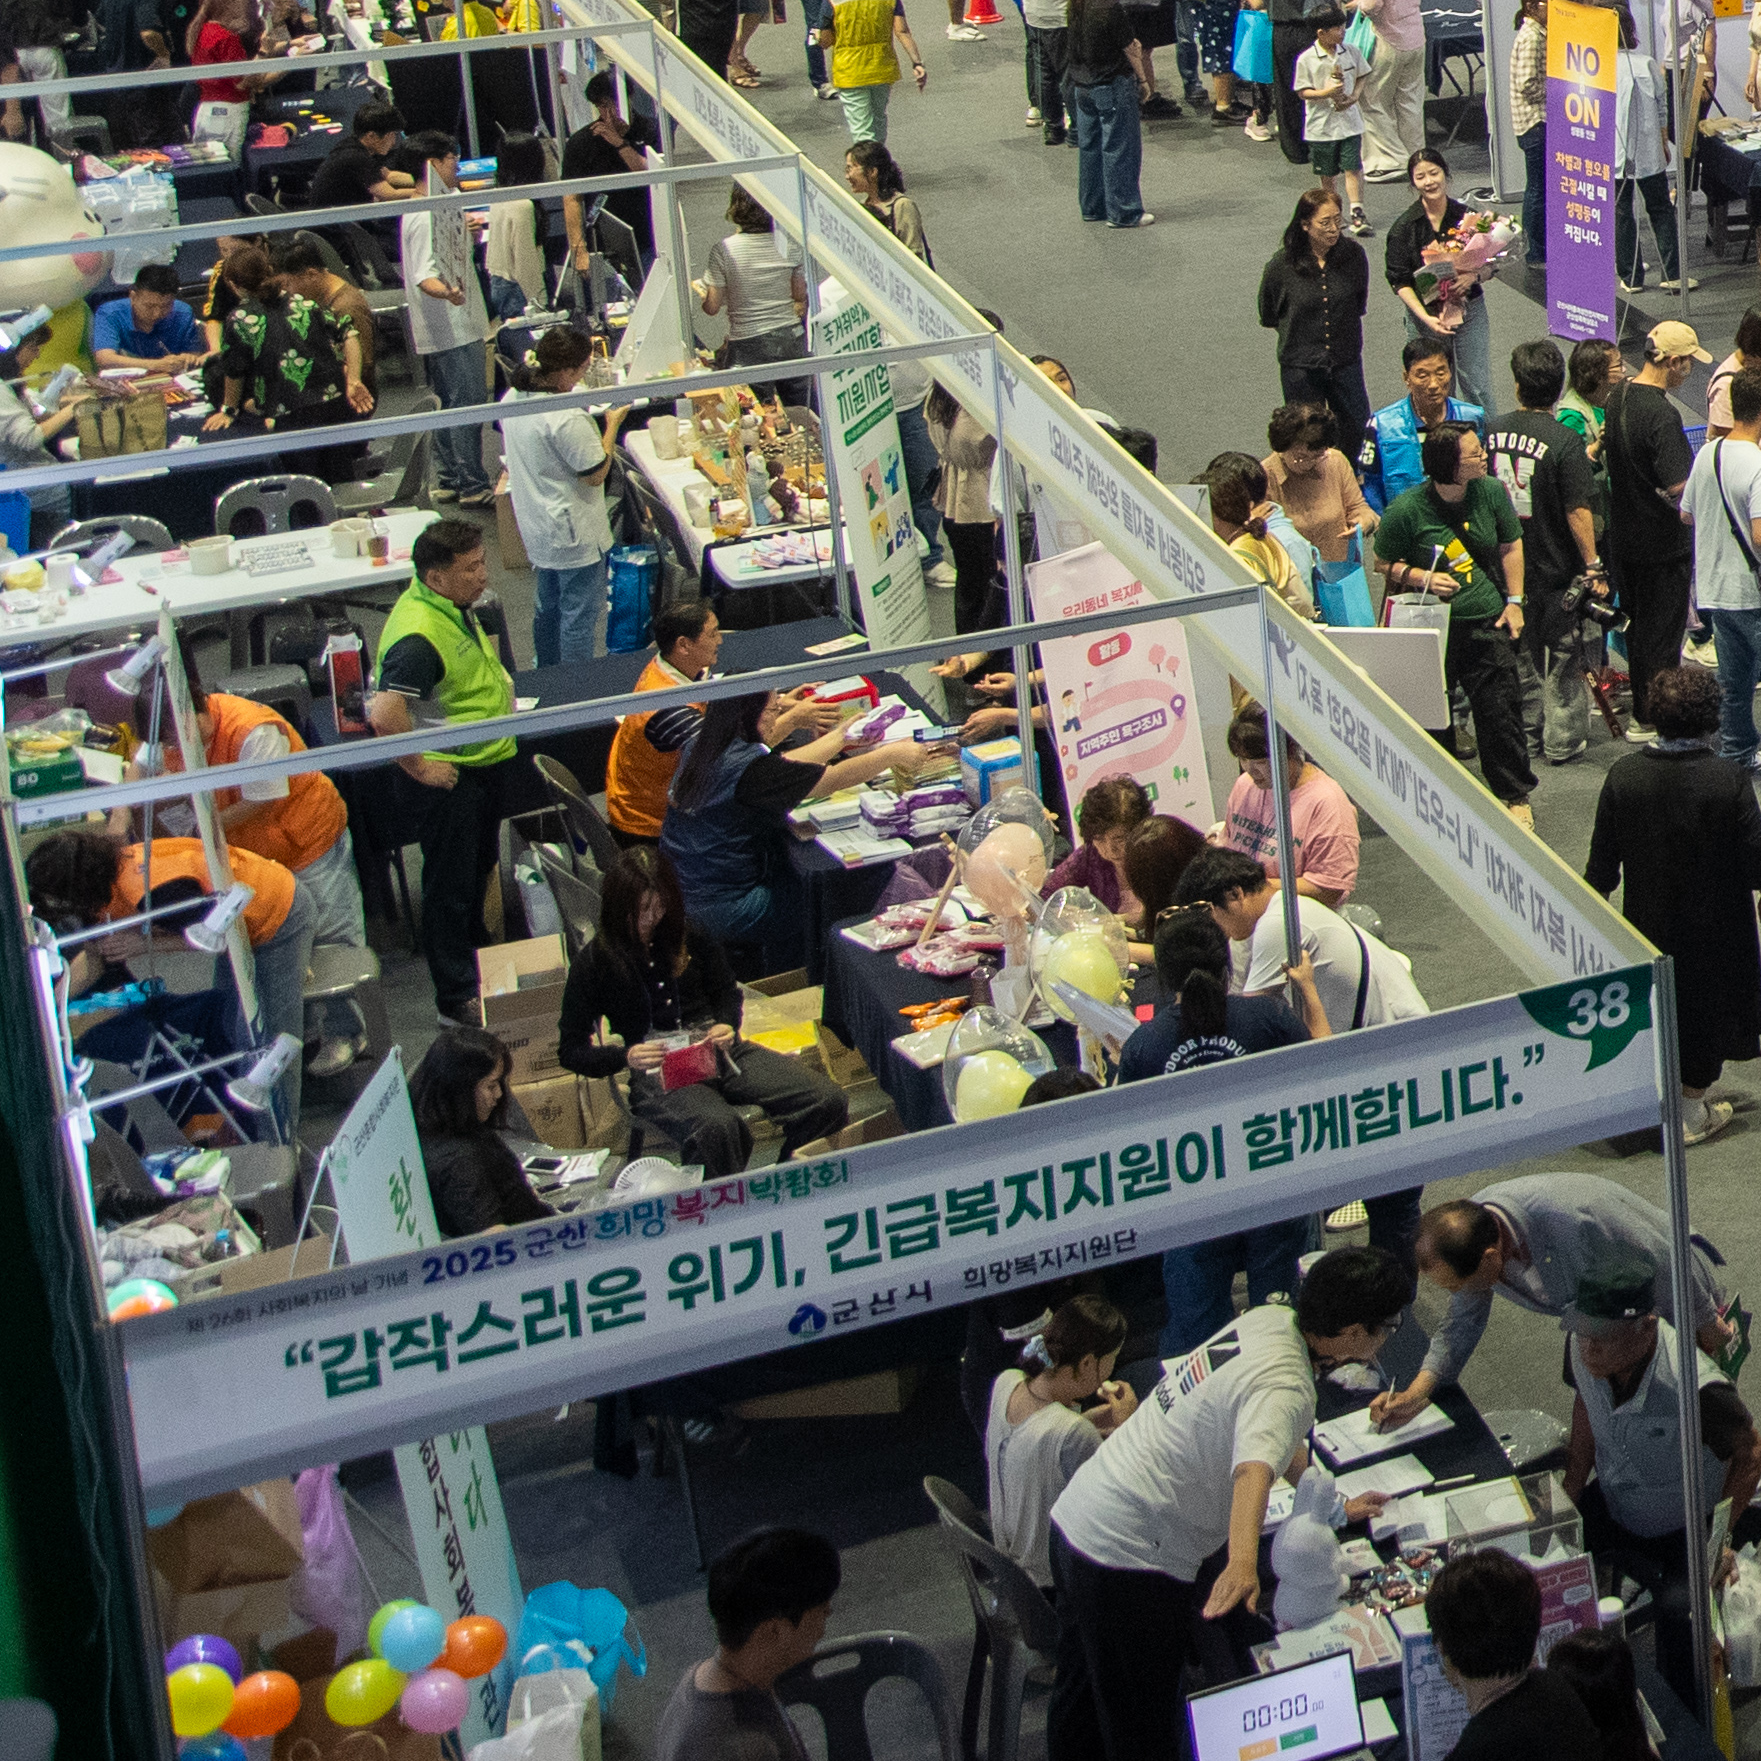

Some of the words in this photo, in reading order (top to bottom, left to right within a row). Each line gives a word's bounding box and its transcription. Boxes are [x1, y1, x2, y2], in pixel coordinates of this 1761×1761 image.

[1565, 41, 1601, 77] NO
[1564, 93, 1600, 129] ON
[1555, 151, 1582, 172] 차별과
[1584, 157, 1611, 181] 혐오를
[1560, 176, 1595, 199] 근절시킬
[1597, 183, 1608, 202] 때
[1565, 201, 1601, 224] 성평등이
[1564, 223, 1603, 247] 켜집니다.
[1488, 431, 1549, 461] SWOOSH
[1080, 729, 1120, 756] 지역주민
[1121, 715, 1164, 741] 욕구조사
[1567, 979, 1631, 1038] 38
[258, 1289, 350, 1321] 사회복지의
[373, 1270, 409, 1298] 기념
[422, 1237, 518, 1286] 2025
[523, 1223, 588, 1259] 군산
[595, 1195, 667, 1239] 희망
[670, 1177, 745, 1224] 복지
[748, 1157, 850, 1206] 박람회
[667, 1230, 806, 1312] 위기,
[824, 1131, 1227, 1280] 긴급복지지원이
[831, 1280, 935, 1326] 군산시
[962, 1227, 1138, 1290] 희망복지지원단
[1242, 1693, 1309, 1733] 00:00
